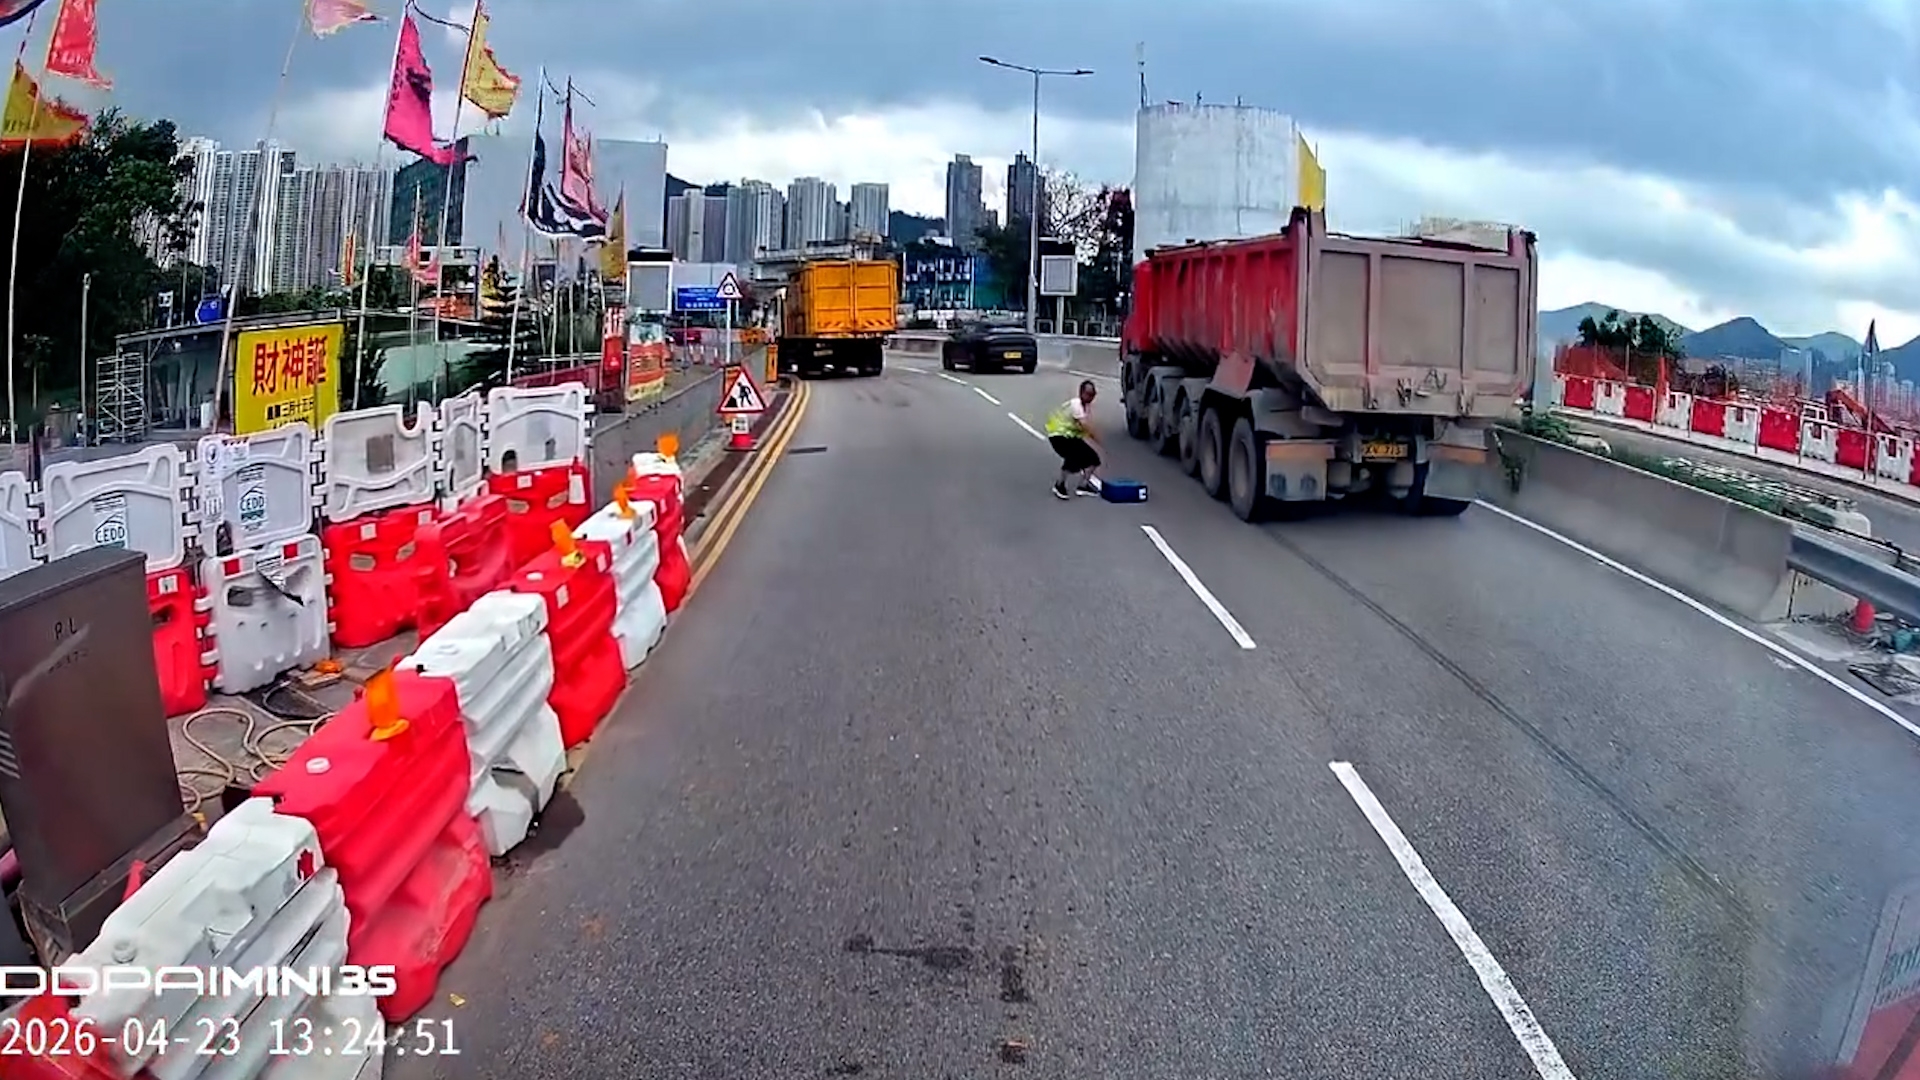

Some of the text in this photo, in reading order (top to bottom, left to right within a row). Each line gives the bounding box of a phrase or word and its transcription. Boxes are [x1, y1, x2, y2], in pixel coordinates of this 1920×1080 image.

[253, 335, 327, 396] 財神誕
[240, 495, 265, 512] CEDD
[95, 526, 125, 544] CEDD
